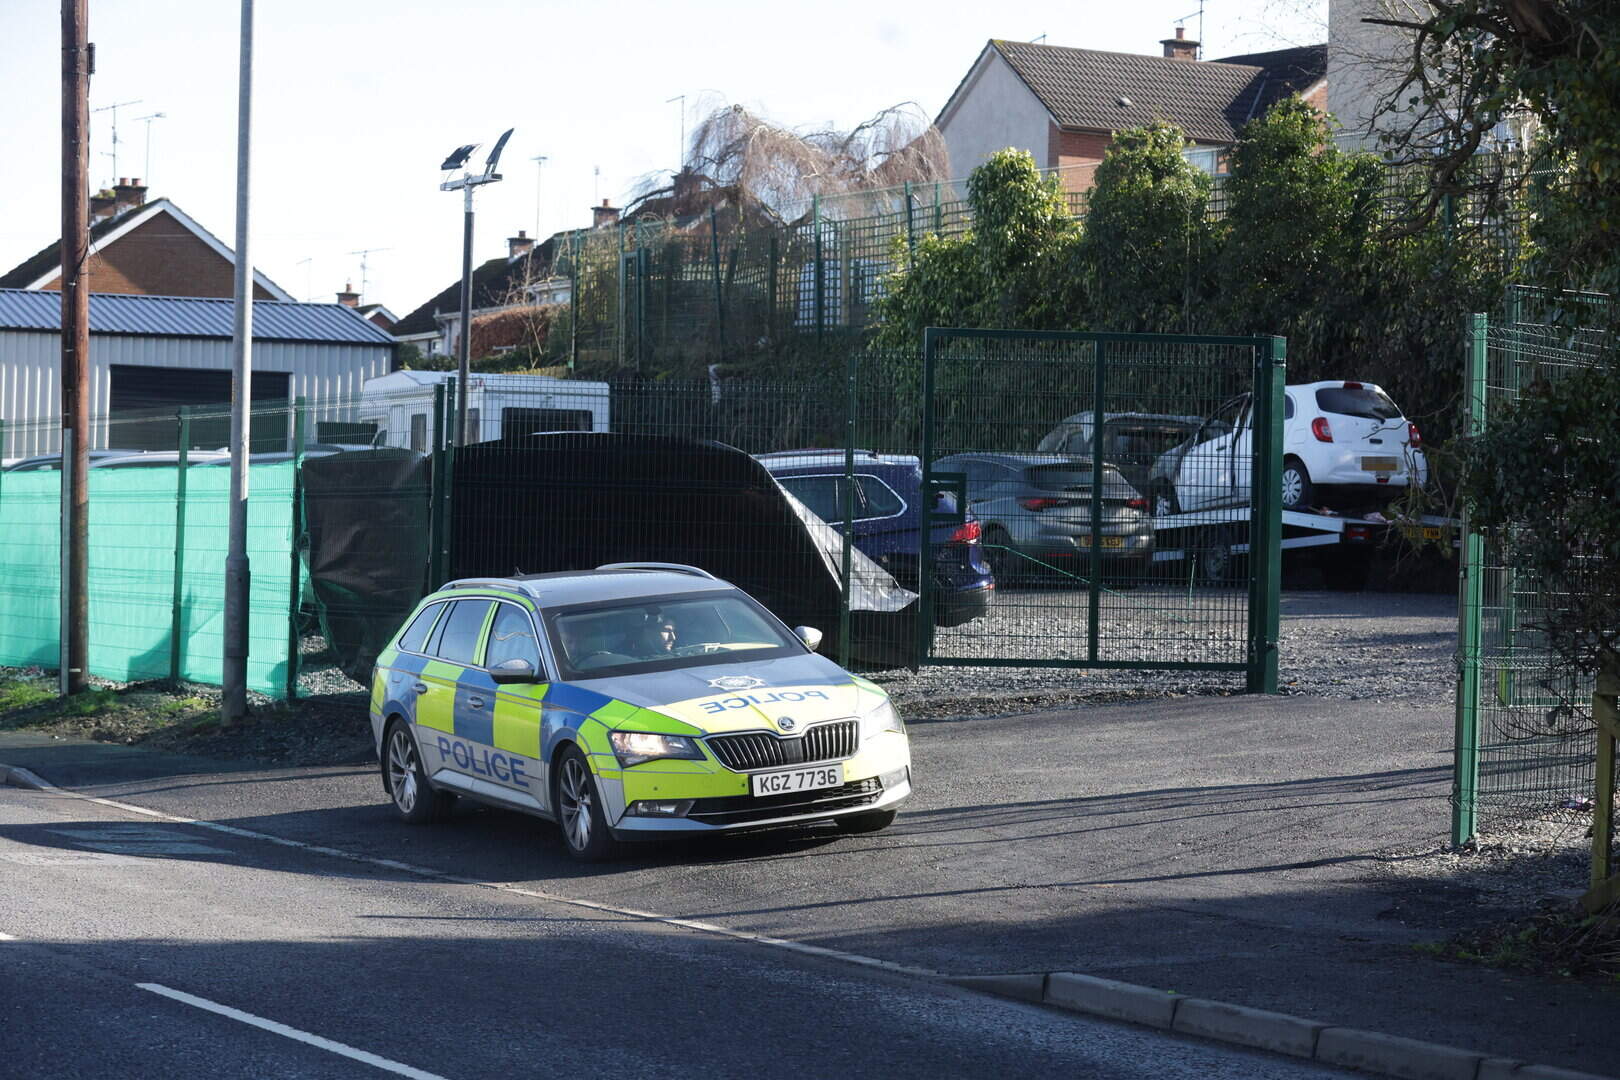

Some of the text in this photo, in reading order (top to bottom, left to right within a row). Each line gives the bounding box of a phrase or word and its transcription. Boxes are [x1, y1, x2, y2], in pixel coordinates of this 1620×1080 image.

[438, 736, 528, 787] POLICE
[760, 769, 837, 793] KGZ 7736
